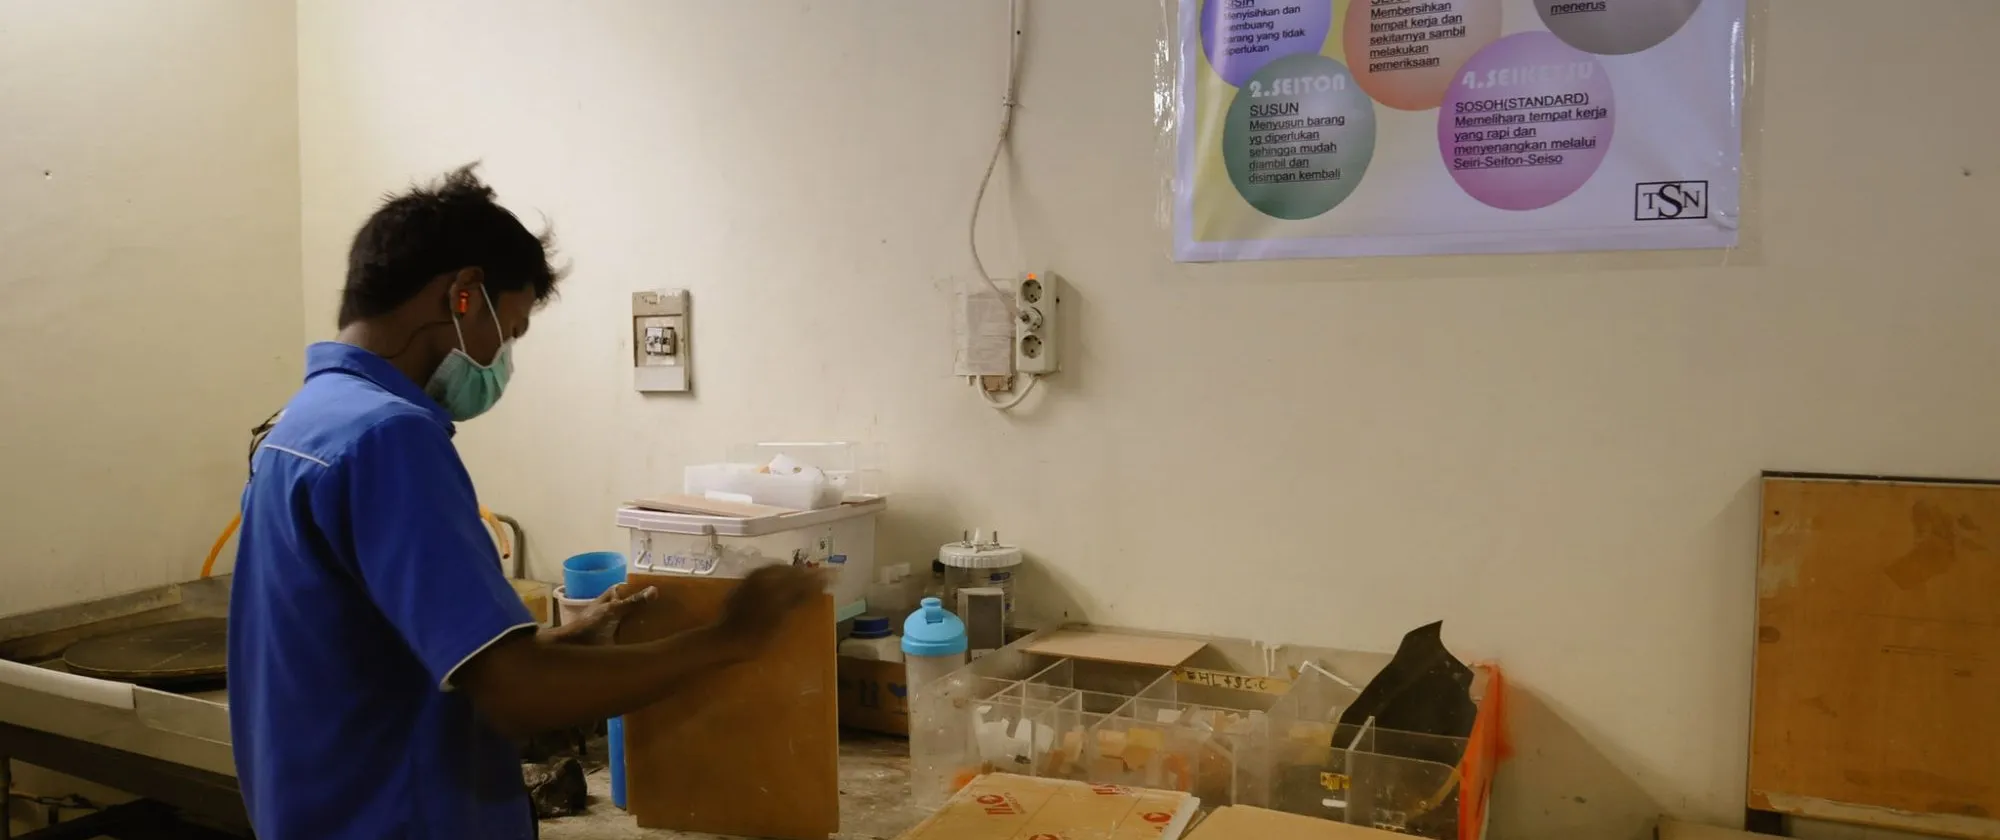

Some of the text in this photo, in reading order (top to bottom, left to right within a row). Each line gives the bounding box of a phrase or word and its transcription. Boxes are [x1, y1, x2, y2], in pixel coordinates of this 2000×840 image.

[1283, 6, 1301, 15] dan
[1371, 2, 1452, 19] Membersihkan
[1551, 1, 1607, 15] menerus
[1226, 21, 1274, 31] embuang
[1370, 14, 1463, 33] tempat kerja dan
[1429, 26, 1466, 38] sambil
[1226, 29, 1306, 43] arang yang tidak
[1369, 44, 1429, 58] melakukan
[1369, 56, 1441, 73] pemeriksaan
[1250, 102, 1300, 116] SUSUN
[1455, 92, 1590, 113] SOSOH(STANDARD)
[1250, 114, 1346, 132] Menyusun barang
[1455, 106, 1608, 128] Memelihara tempat kerja
[1250, 130, 1320, 146] yg diperlukan
[1454, 126, 1537, 143] yang rapi dan
[1249, 142, 1338, 158] sehingga mudah
[1454, 136, 1597, 156] menyenangkan melalui
[1249, 157, 1310, 171] diambil dan
[1453, 152, 1564, 170] Seiri-Seiton-Seiso
[1249, 168, 1341, 185] disimpan kembali
[1643, 183, 1701, 219] TSN
